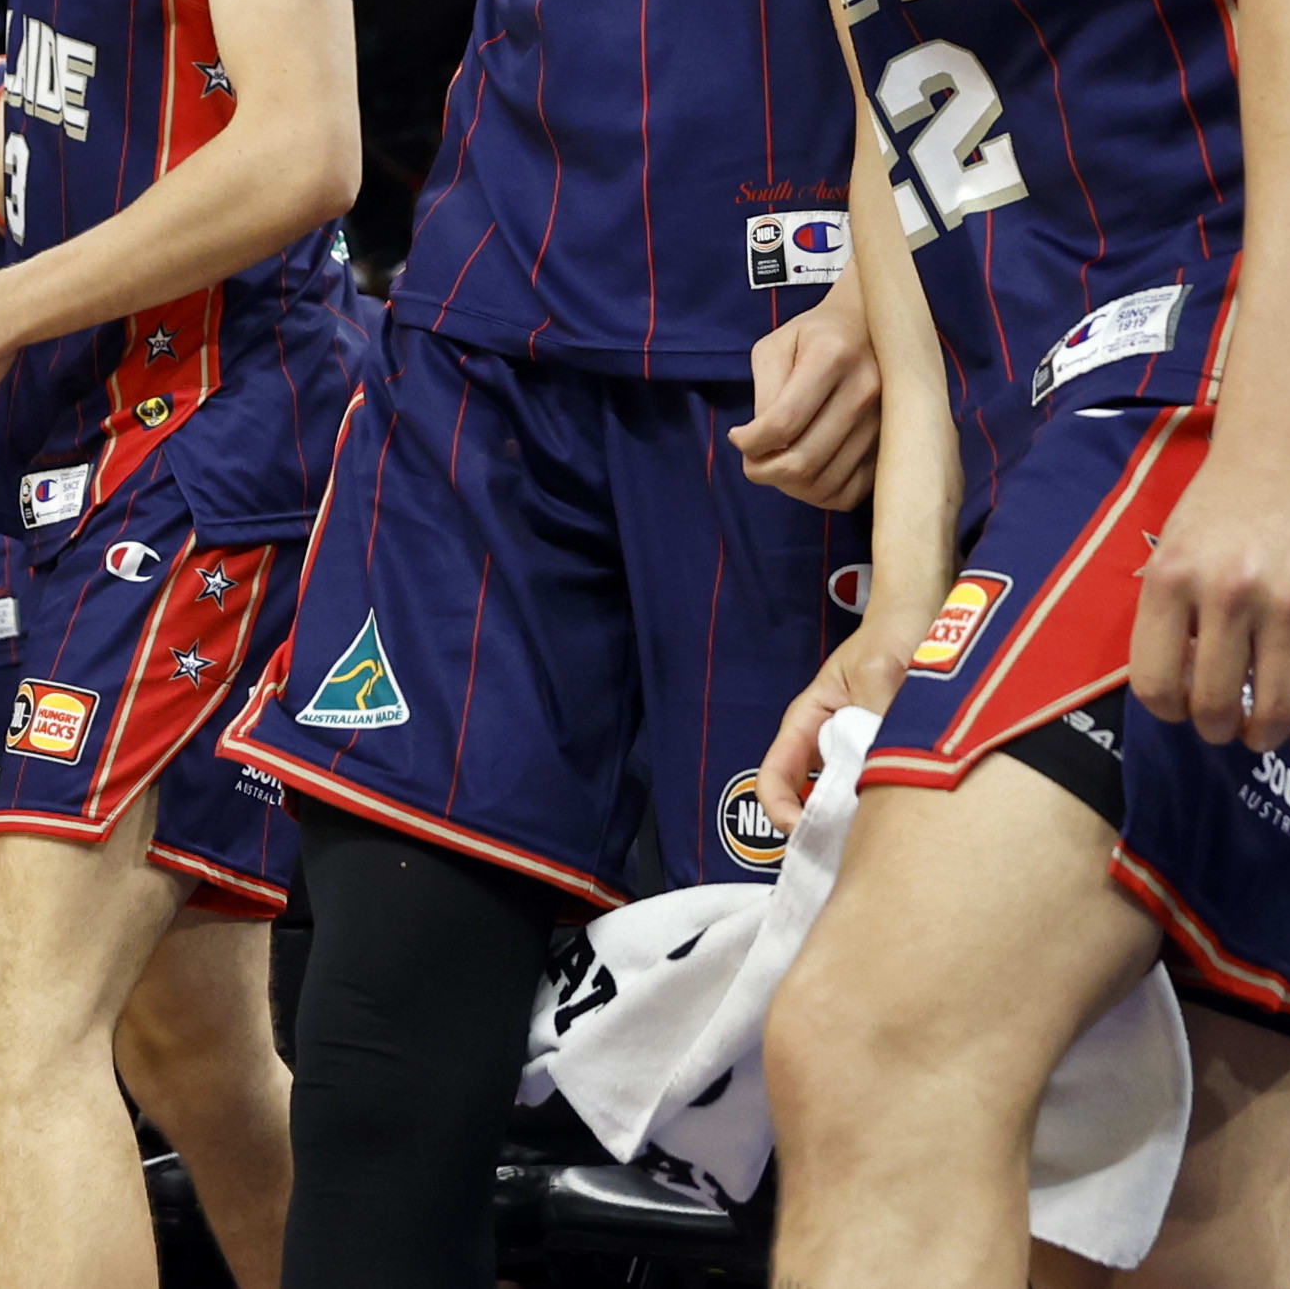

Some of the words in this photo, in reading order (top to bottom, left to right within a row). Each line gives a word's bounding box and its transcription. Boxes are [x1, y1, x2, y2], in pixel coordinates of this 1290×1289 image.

[756, 226, 777, 243] NBL
[793, 265, 845, 278] Champio
[37, 708, 81, 724] HUNGRY
[300, 713, 373, 725] AUSTRALIAN
[375, 710, 404, 722] MADE
[34, 719, 76, 740] JACK'S
[737, 799, 785, 840] NB
